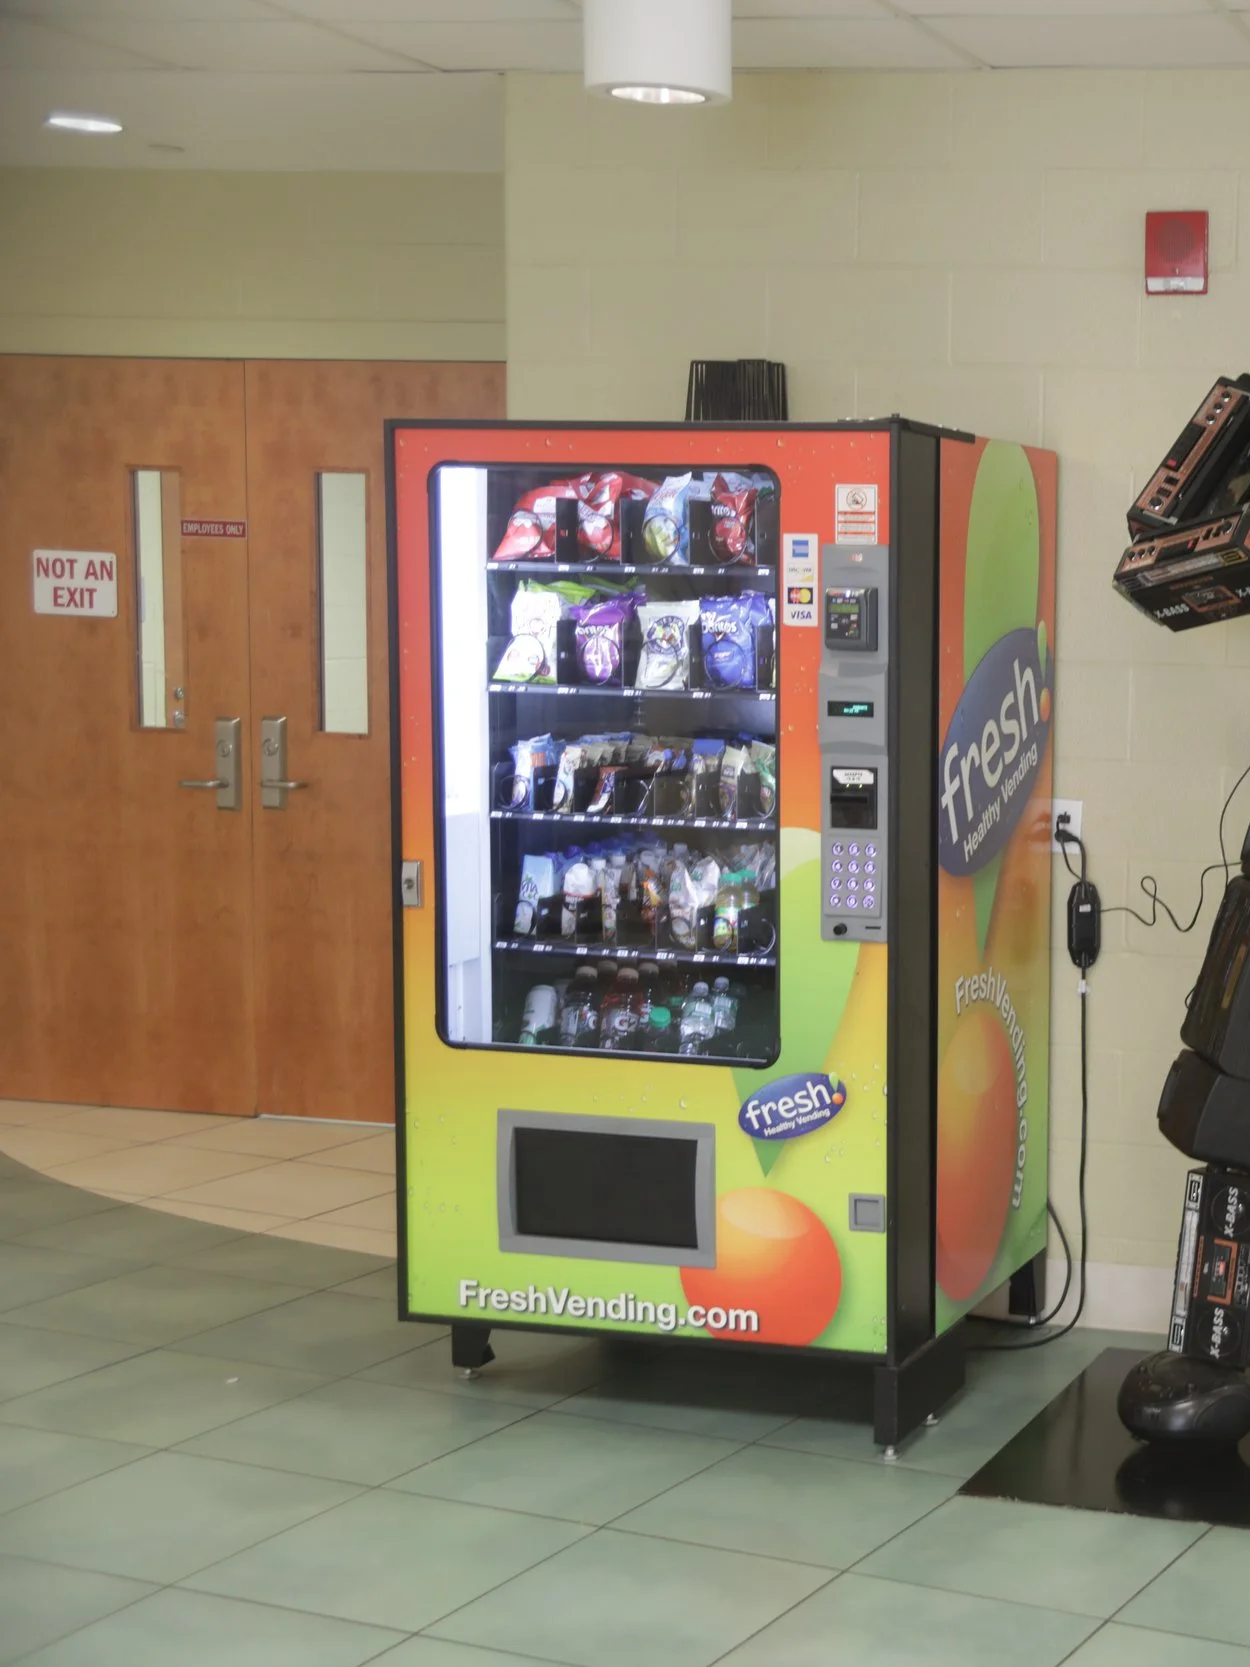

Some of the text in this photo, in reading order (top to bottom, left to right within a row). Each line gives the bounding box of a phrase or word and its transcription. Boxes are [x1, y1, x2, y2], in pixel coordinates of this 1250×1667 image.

[183, 523, 243, 535] EMPLOYEES ONLY
[36, 557, 114, 581] NOT AN
[53, 586, 97, 609] EXIT
[791, 611, 812, 620] VISA
[1154, 603, 1190, 619] X-BASS
[963, 742, 1037, 862] Healthy Vending
[614, 1015, 638, 1033] G2
[955, 967, 1027, 1208] FreshVending.com
[763, 1108, 830, 1136] Healthy Vending
[1224, 1186, 1238, 1237] X-BASS
[459, 1280, 759, 1332] FreshVending.com
[1210, 1307, 1224, 1359] X-BASS
